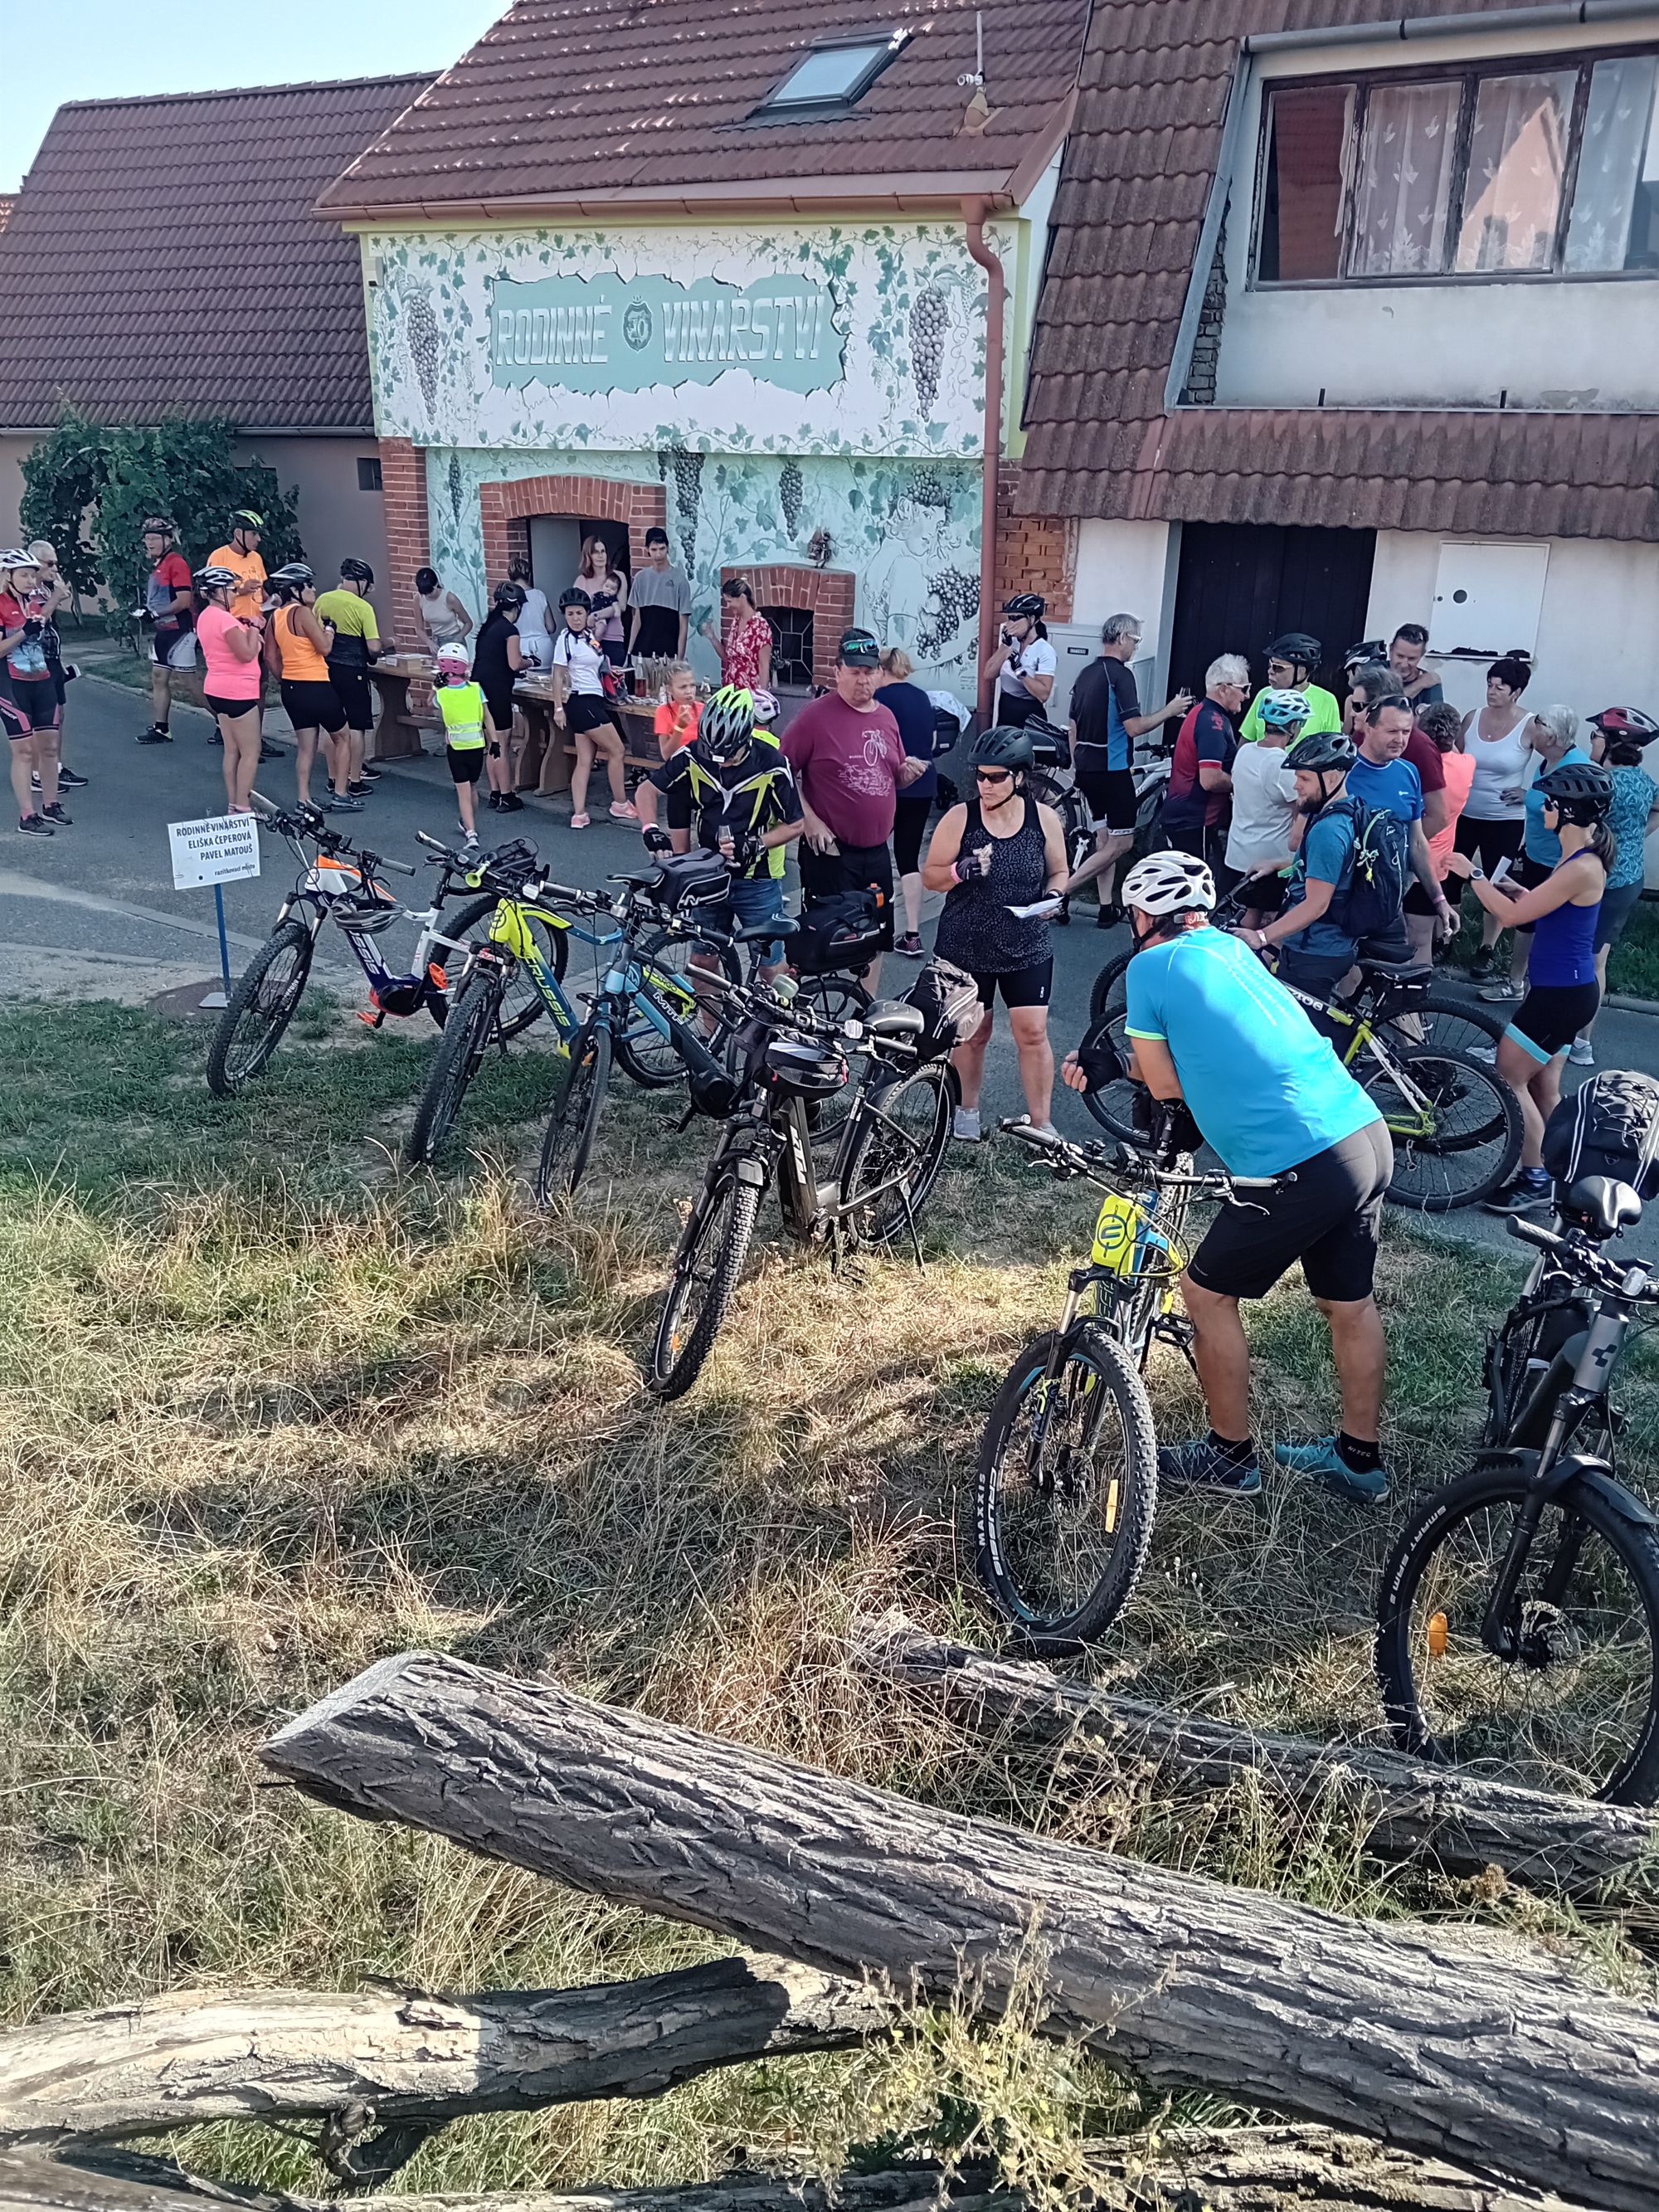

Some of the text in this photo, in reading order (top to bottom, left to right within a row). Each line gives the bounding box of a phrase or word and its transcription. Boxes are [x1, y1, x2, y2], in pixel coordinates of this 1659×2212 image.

[496, 295, 612, 365] RODINNÉ
[176, 817, 250, 837] RODINNÉ VINAŘSTVÍ
[187, 831, 252, 849] ELIŠKA ČEPEROVÁ
[200, 843, 253, 860] PAVEL MATOUŠ
[977, 1473, 986, 1547] MAXXIS
[1392, 1505, 1447, 1591] SMART SAM
